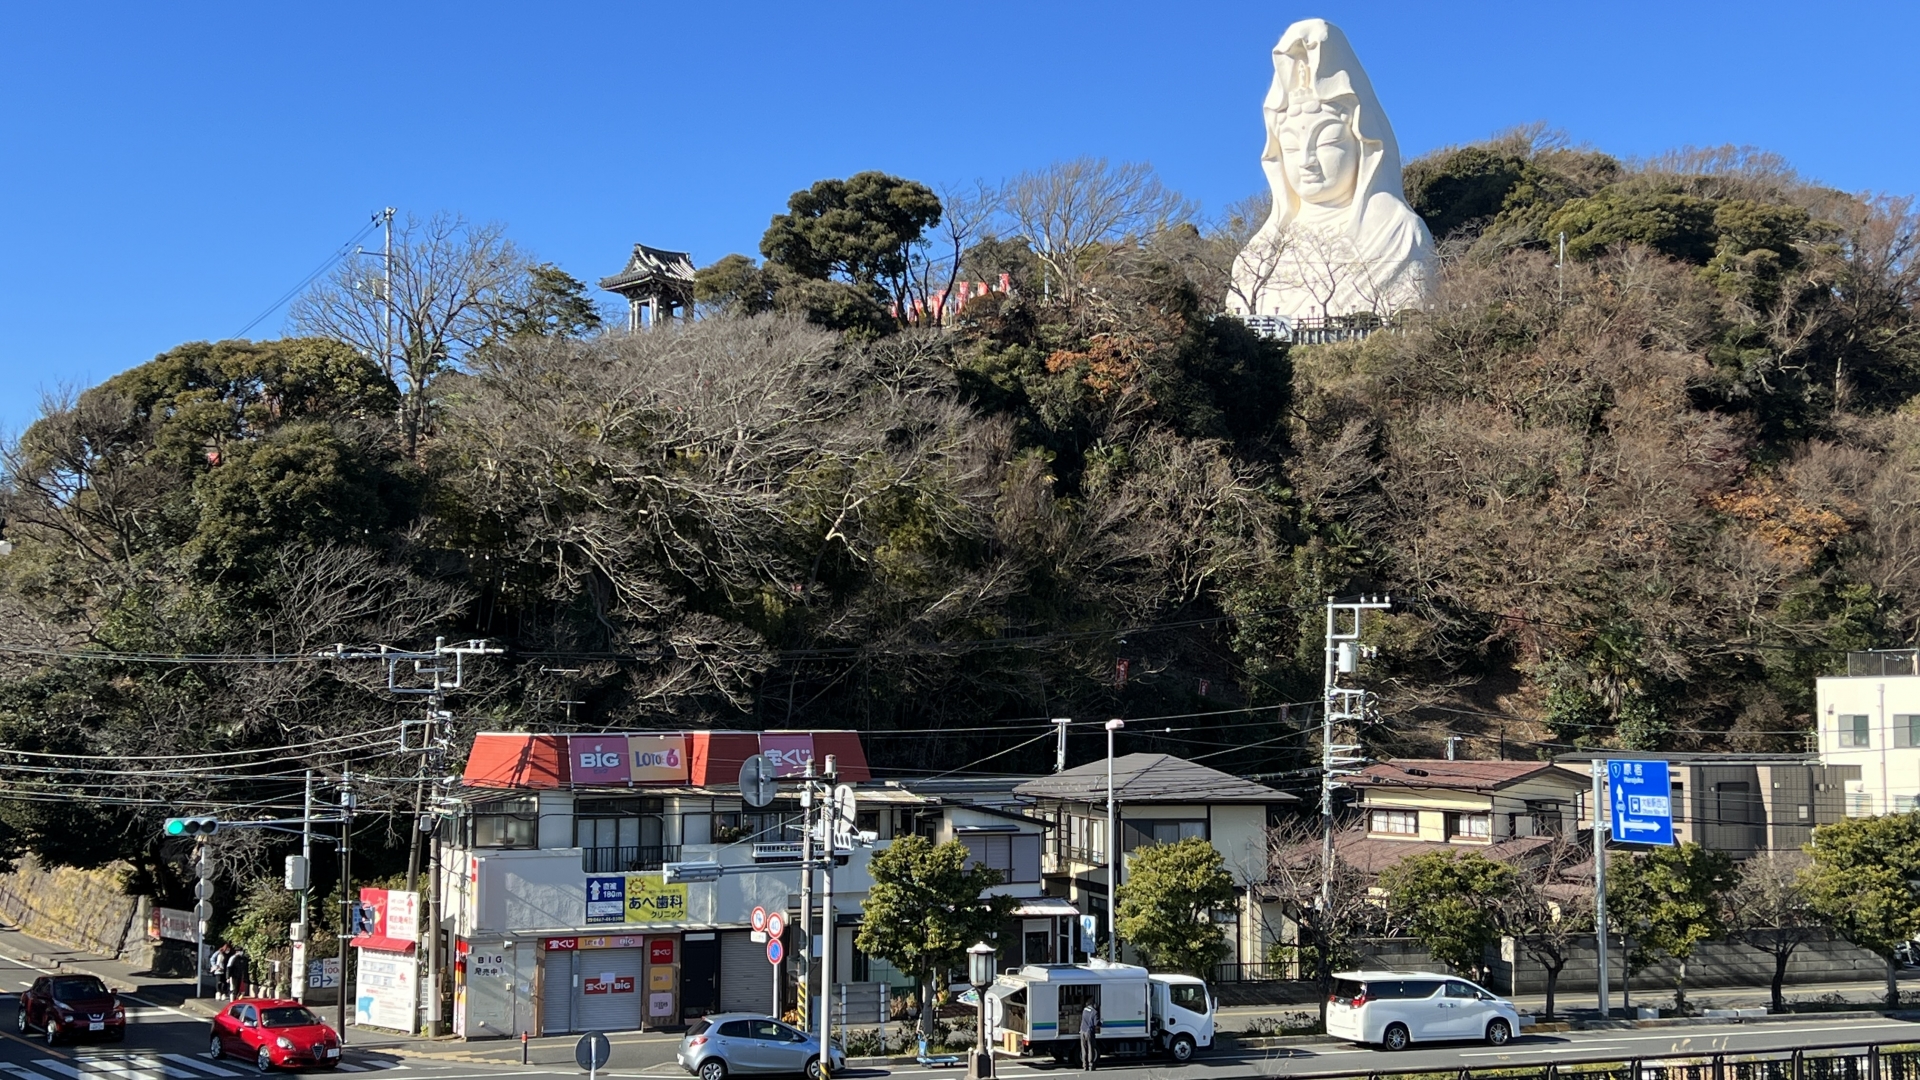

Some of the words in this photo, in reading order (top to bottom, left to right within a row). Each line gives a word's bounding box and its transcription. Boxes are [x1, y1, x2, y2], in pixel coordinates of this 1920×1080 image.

[579, 744, 620, 768] BIG
[635, 751, 661, 768] LOTO
[666, 748, 680, 768] 6
[764, 749, 812, 767] 宝くじ
[1623, 763, 1643, 776] 原宿
[603, 890, 623, 899] 180m
[628, 895, 684, 911] あべ歯科
[651, 910, 684, 919] クリニック
[771, 921, 780, 931] 40
[549, 939, 575, 949] 宝くじ
[619, 936, 635, 945] BIG
[652, 948, 671, 956] 宝くじ
[324, 966, 339, 974] 100
[585, 983, 607, 991] 宝くじ
[614, 979, 631, 990] BIG
